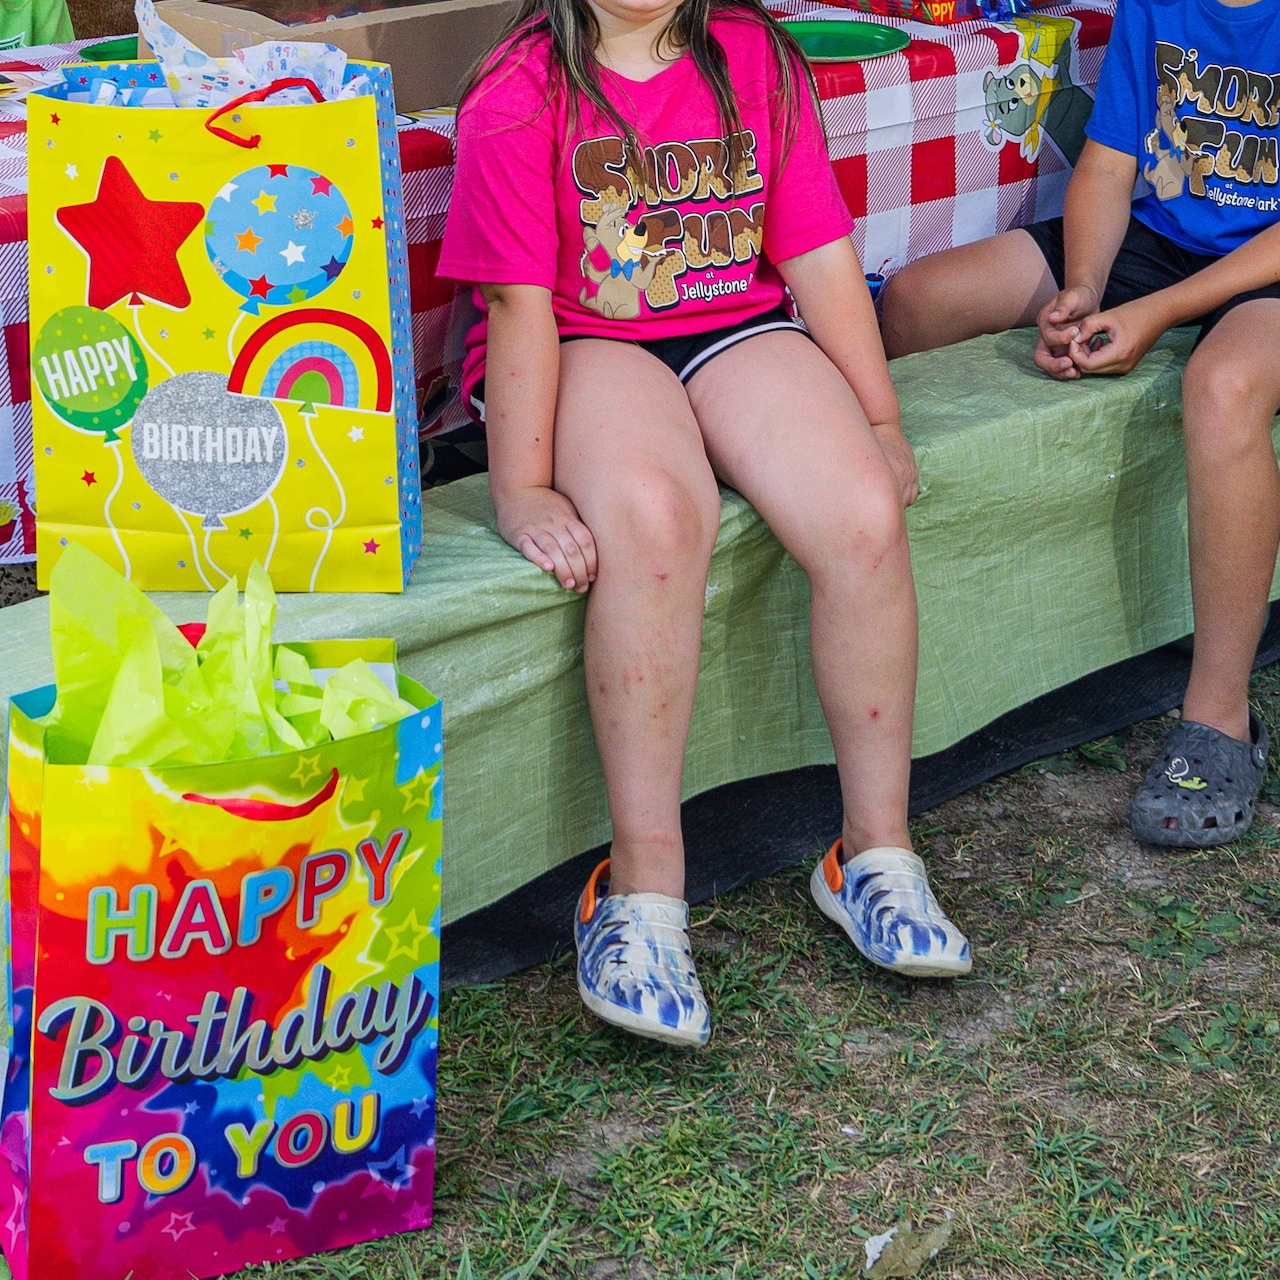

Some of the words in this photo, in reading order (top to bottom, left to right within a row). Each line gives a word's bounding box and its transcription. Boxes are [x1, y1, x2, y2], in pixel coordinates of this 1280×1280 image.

[1181, 115, 1280, 201] FUN
[636, 202, 766, 313] FUN
[681, 278, 748, 301] Jellystone
[705, 271, 715, 279] at
[40, 334, 137, 400] HAPPY
[142, 422, 279, 464] BIRTHDAY
[86, 827, 412, 965] HAPPY
[37, 963, 434, 1107] Birthday
[82, 1131, 198, 1204] TO
[223, 1092, 382, 1179] YOU
